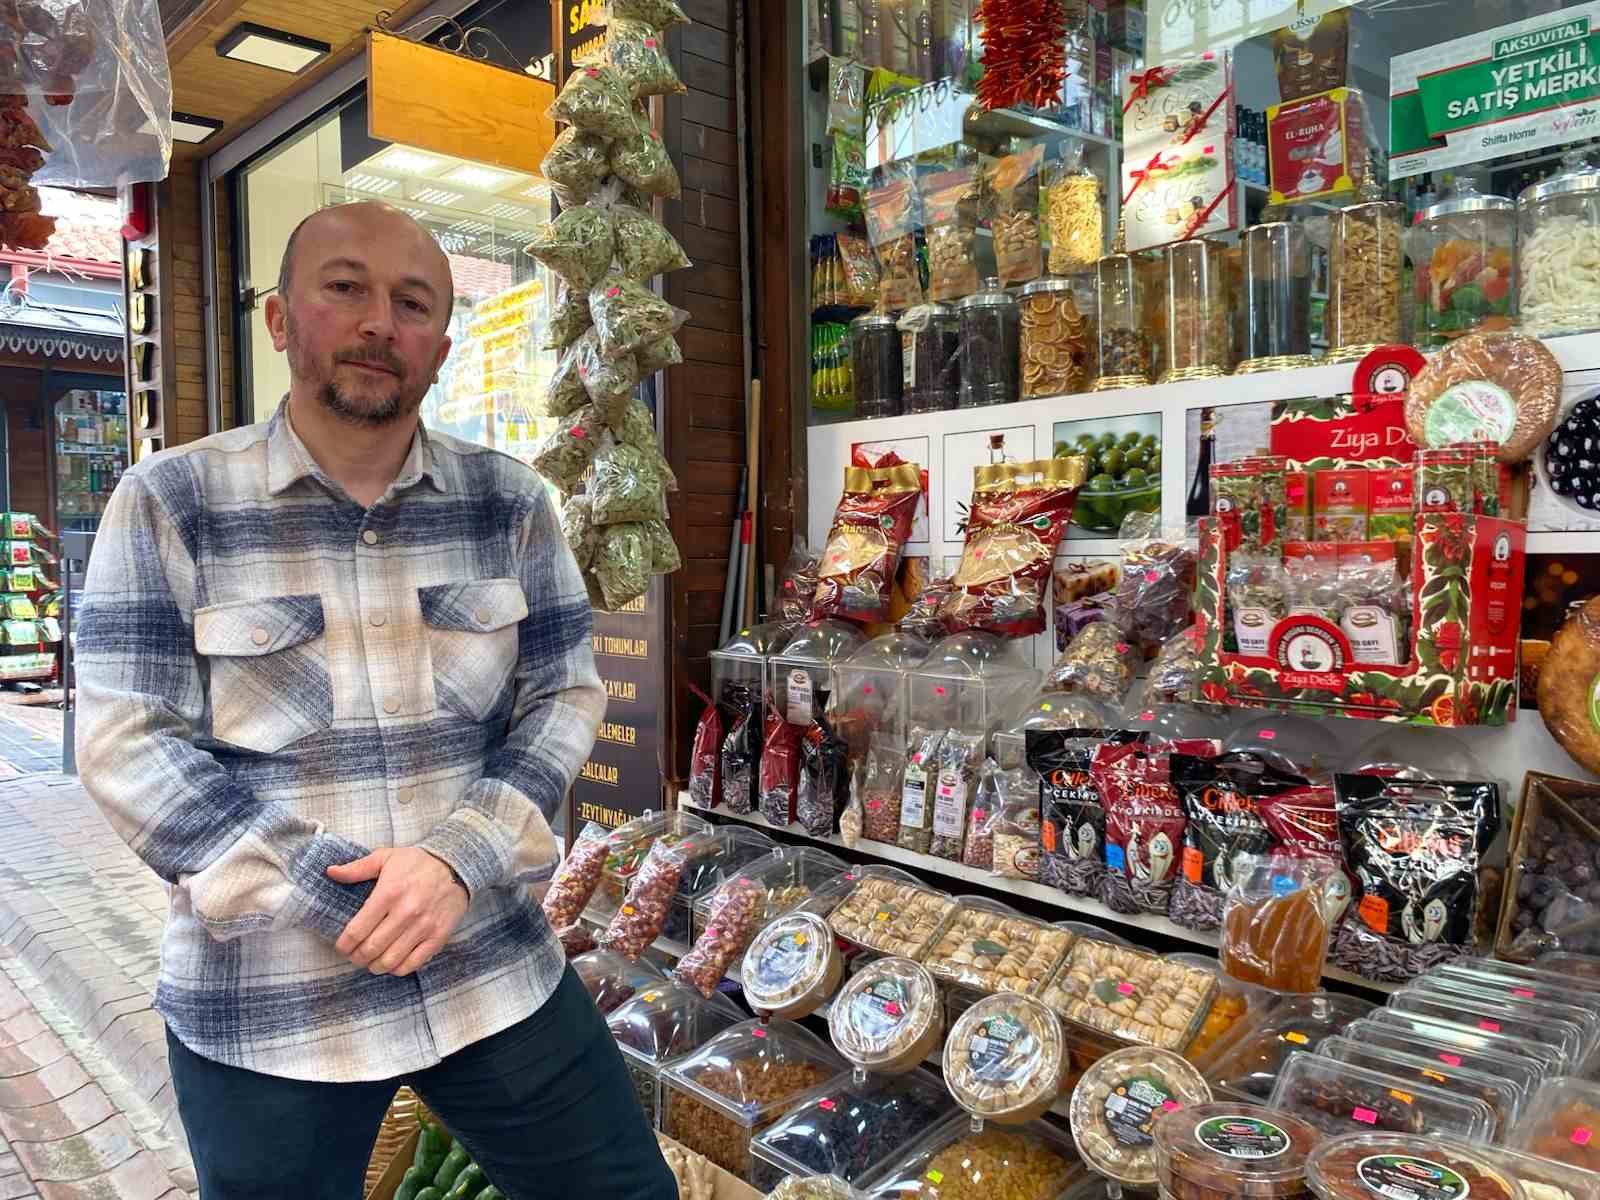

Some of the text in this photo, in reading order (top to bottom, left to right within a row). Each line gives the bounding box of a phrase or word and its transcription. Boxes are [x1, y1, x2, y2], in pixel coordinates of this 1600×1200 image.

[1490, 40, 1587, 86] YETKİLİ
[1447, 64, 1600, 119] SATIŞ MERK
[1481, 128, 1536, 148] Shiffa Home
[1330, 426, 1416, 456] Ziya De
[604, 637, 648, 657] TOHUMLARI
